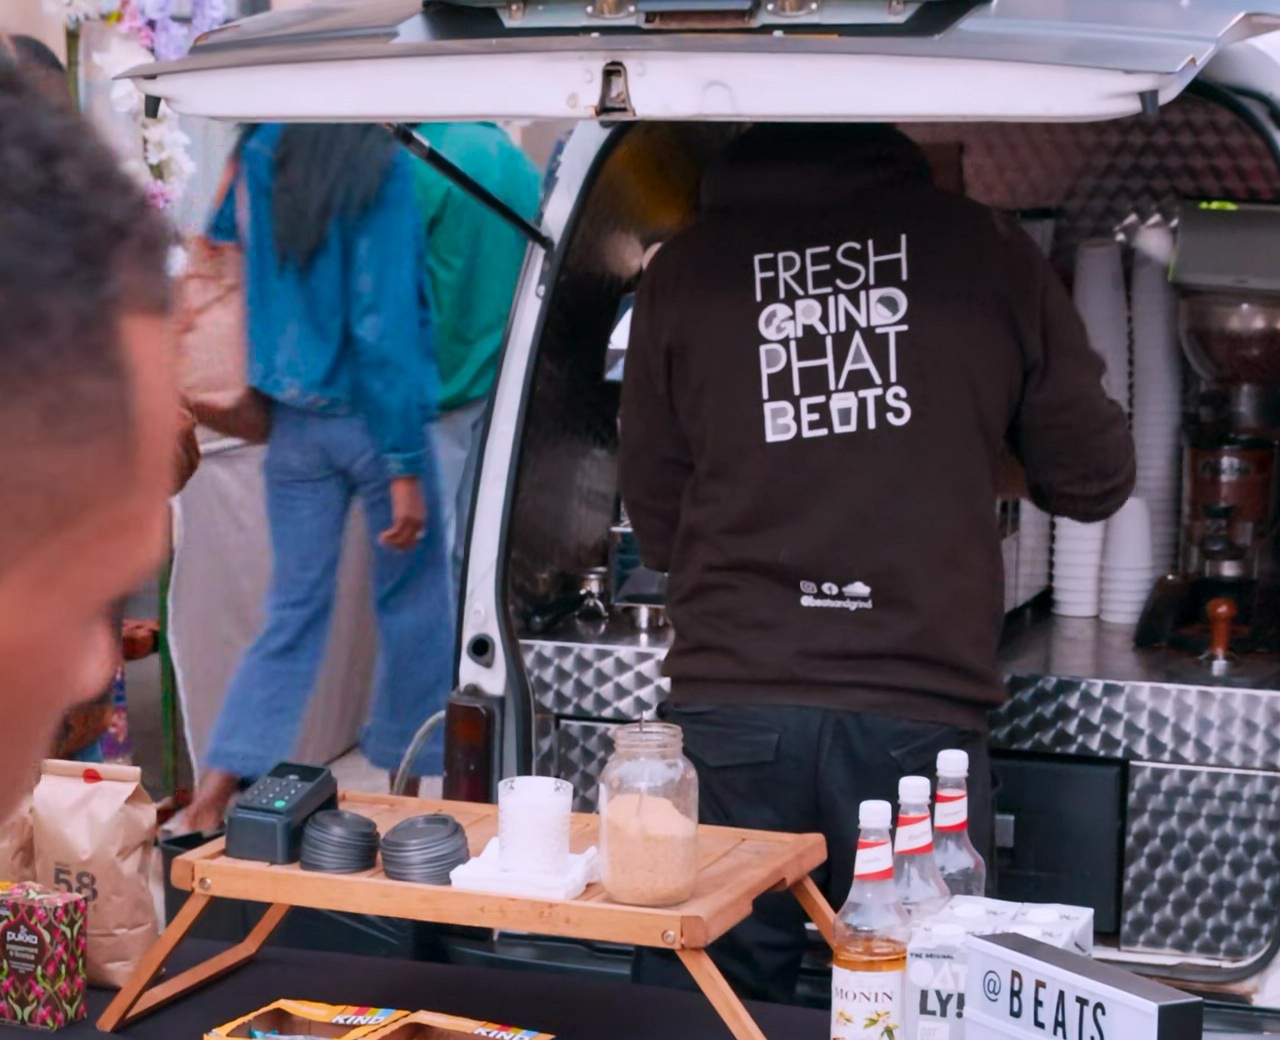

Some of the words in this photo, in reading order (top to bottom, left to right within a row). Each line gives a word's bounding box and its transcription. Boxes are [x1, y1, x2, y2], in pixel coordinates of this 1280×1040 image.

[754, 233, 907, 302] FRESH
[758, 286, 908, 341] GRIND
[759, 324, 909, 400] PHAT
[53, 867, 98, 902] 58
[6, 929, 39, 945] pukka
[835, 986, 894, 1004] MONIN
[919, 988, 966, 1020] LY!
[331, 1014, 387, 1026] KIND
